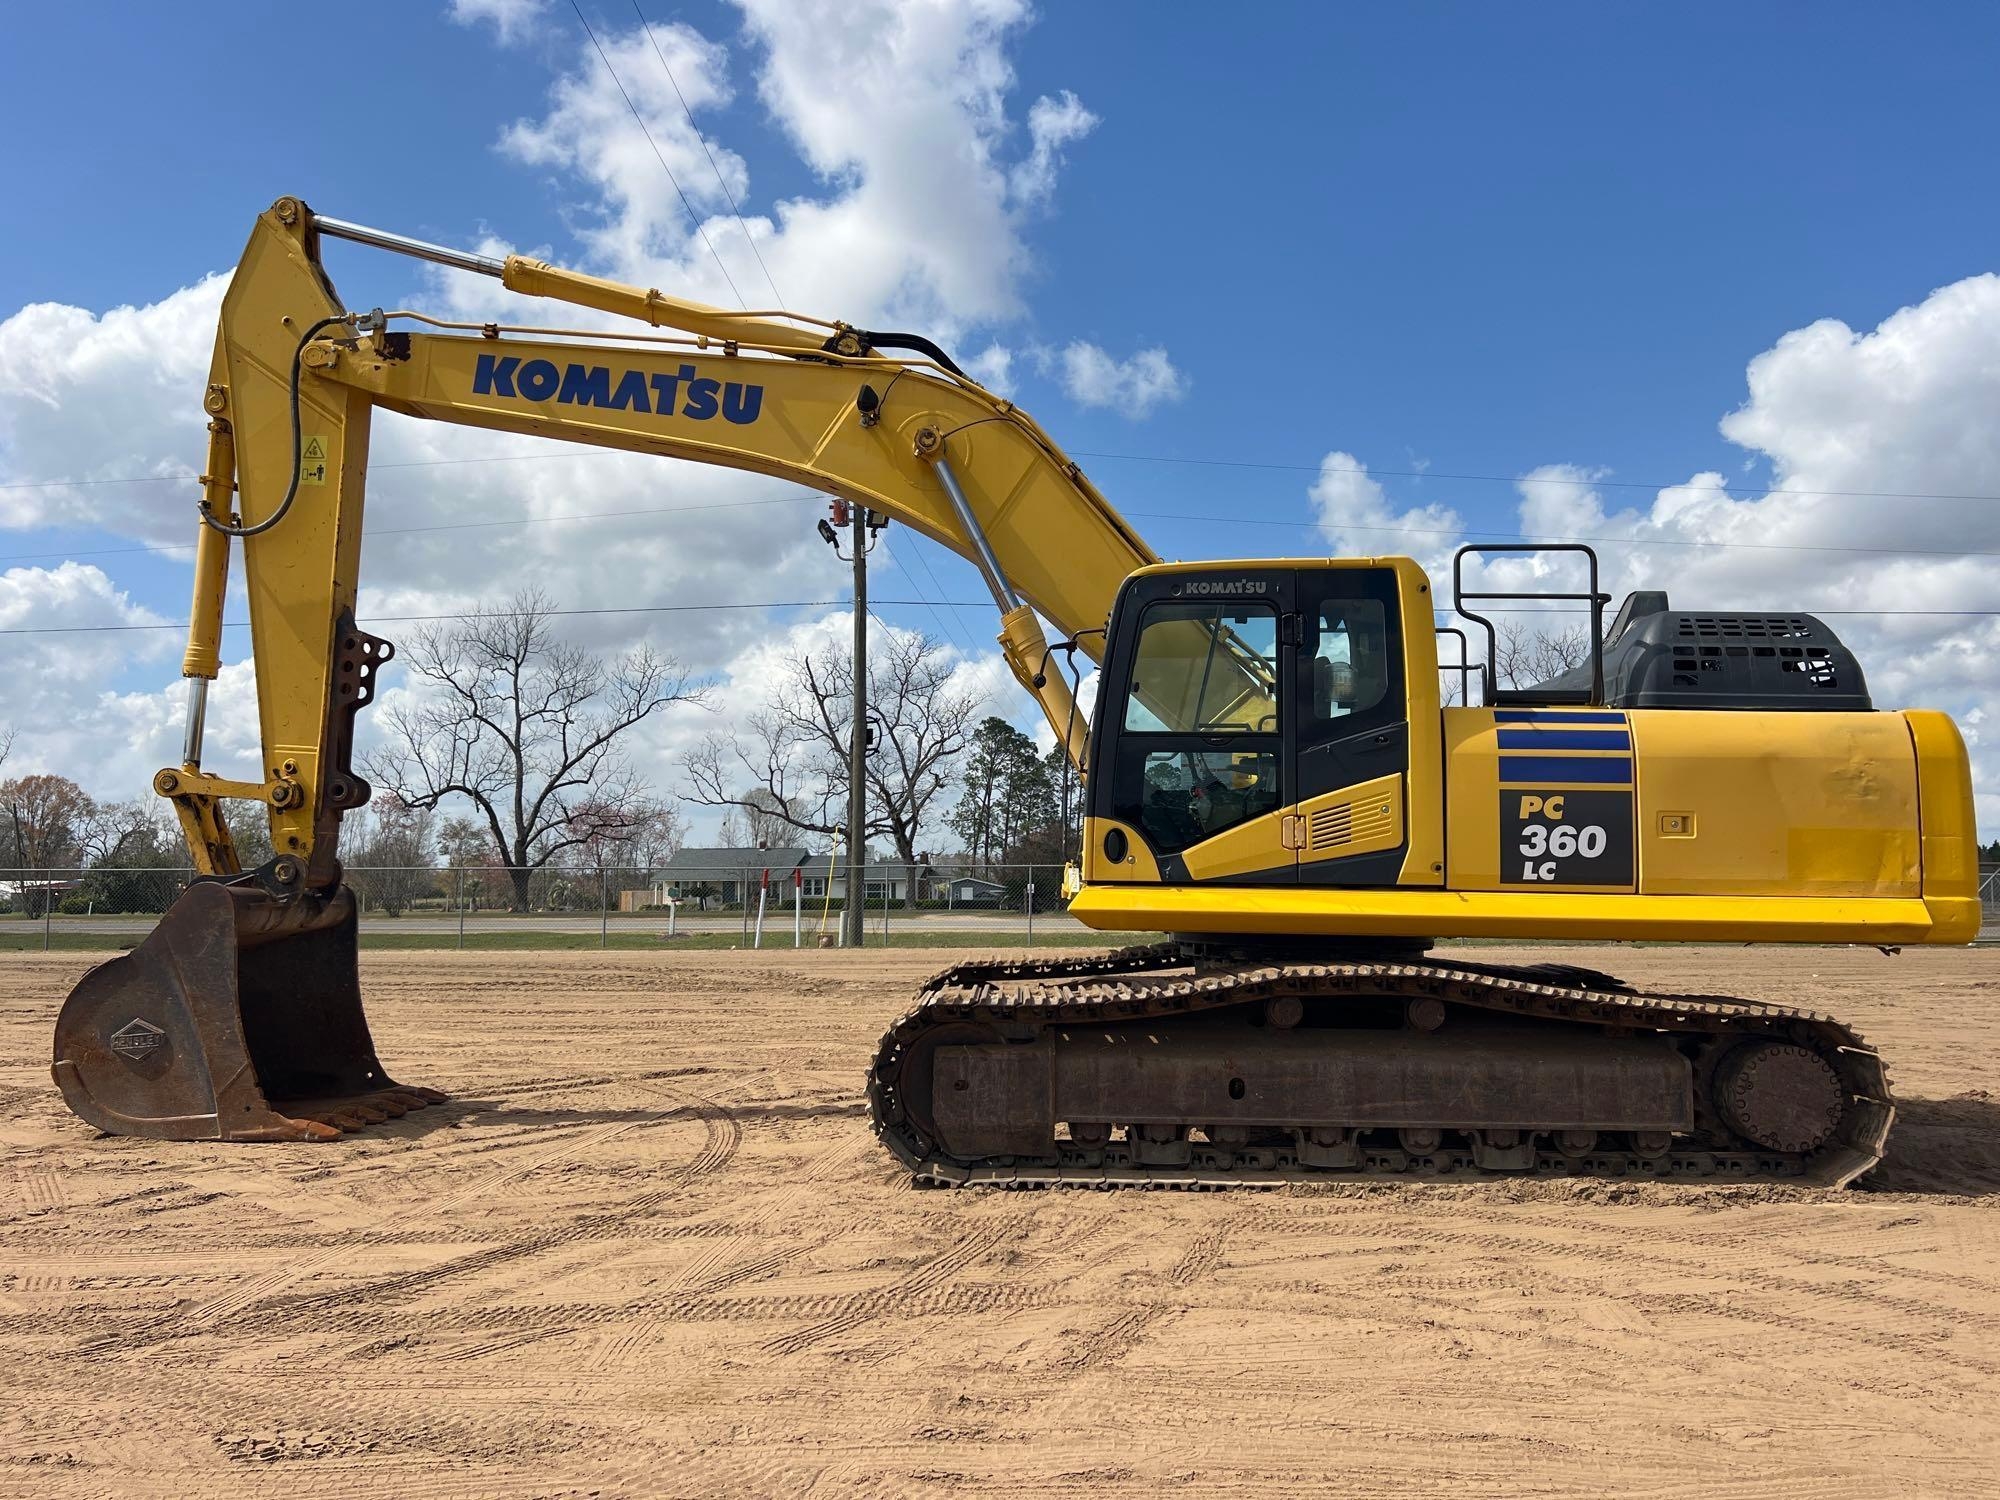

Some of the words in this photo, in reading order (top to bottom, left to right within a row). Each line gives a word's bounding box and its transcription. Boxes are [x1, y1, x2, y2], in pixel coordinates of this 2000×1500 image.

[473, 354, 764, 424] KOMATSU
[1186, 578, 1267, 594] KOMATSU
[1519, 795, 1565, 820] PC
[1519, 824, 1607, 858] 360
[1522, 861, 1557, 880] LC
